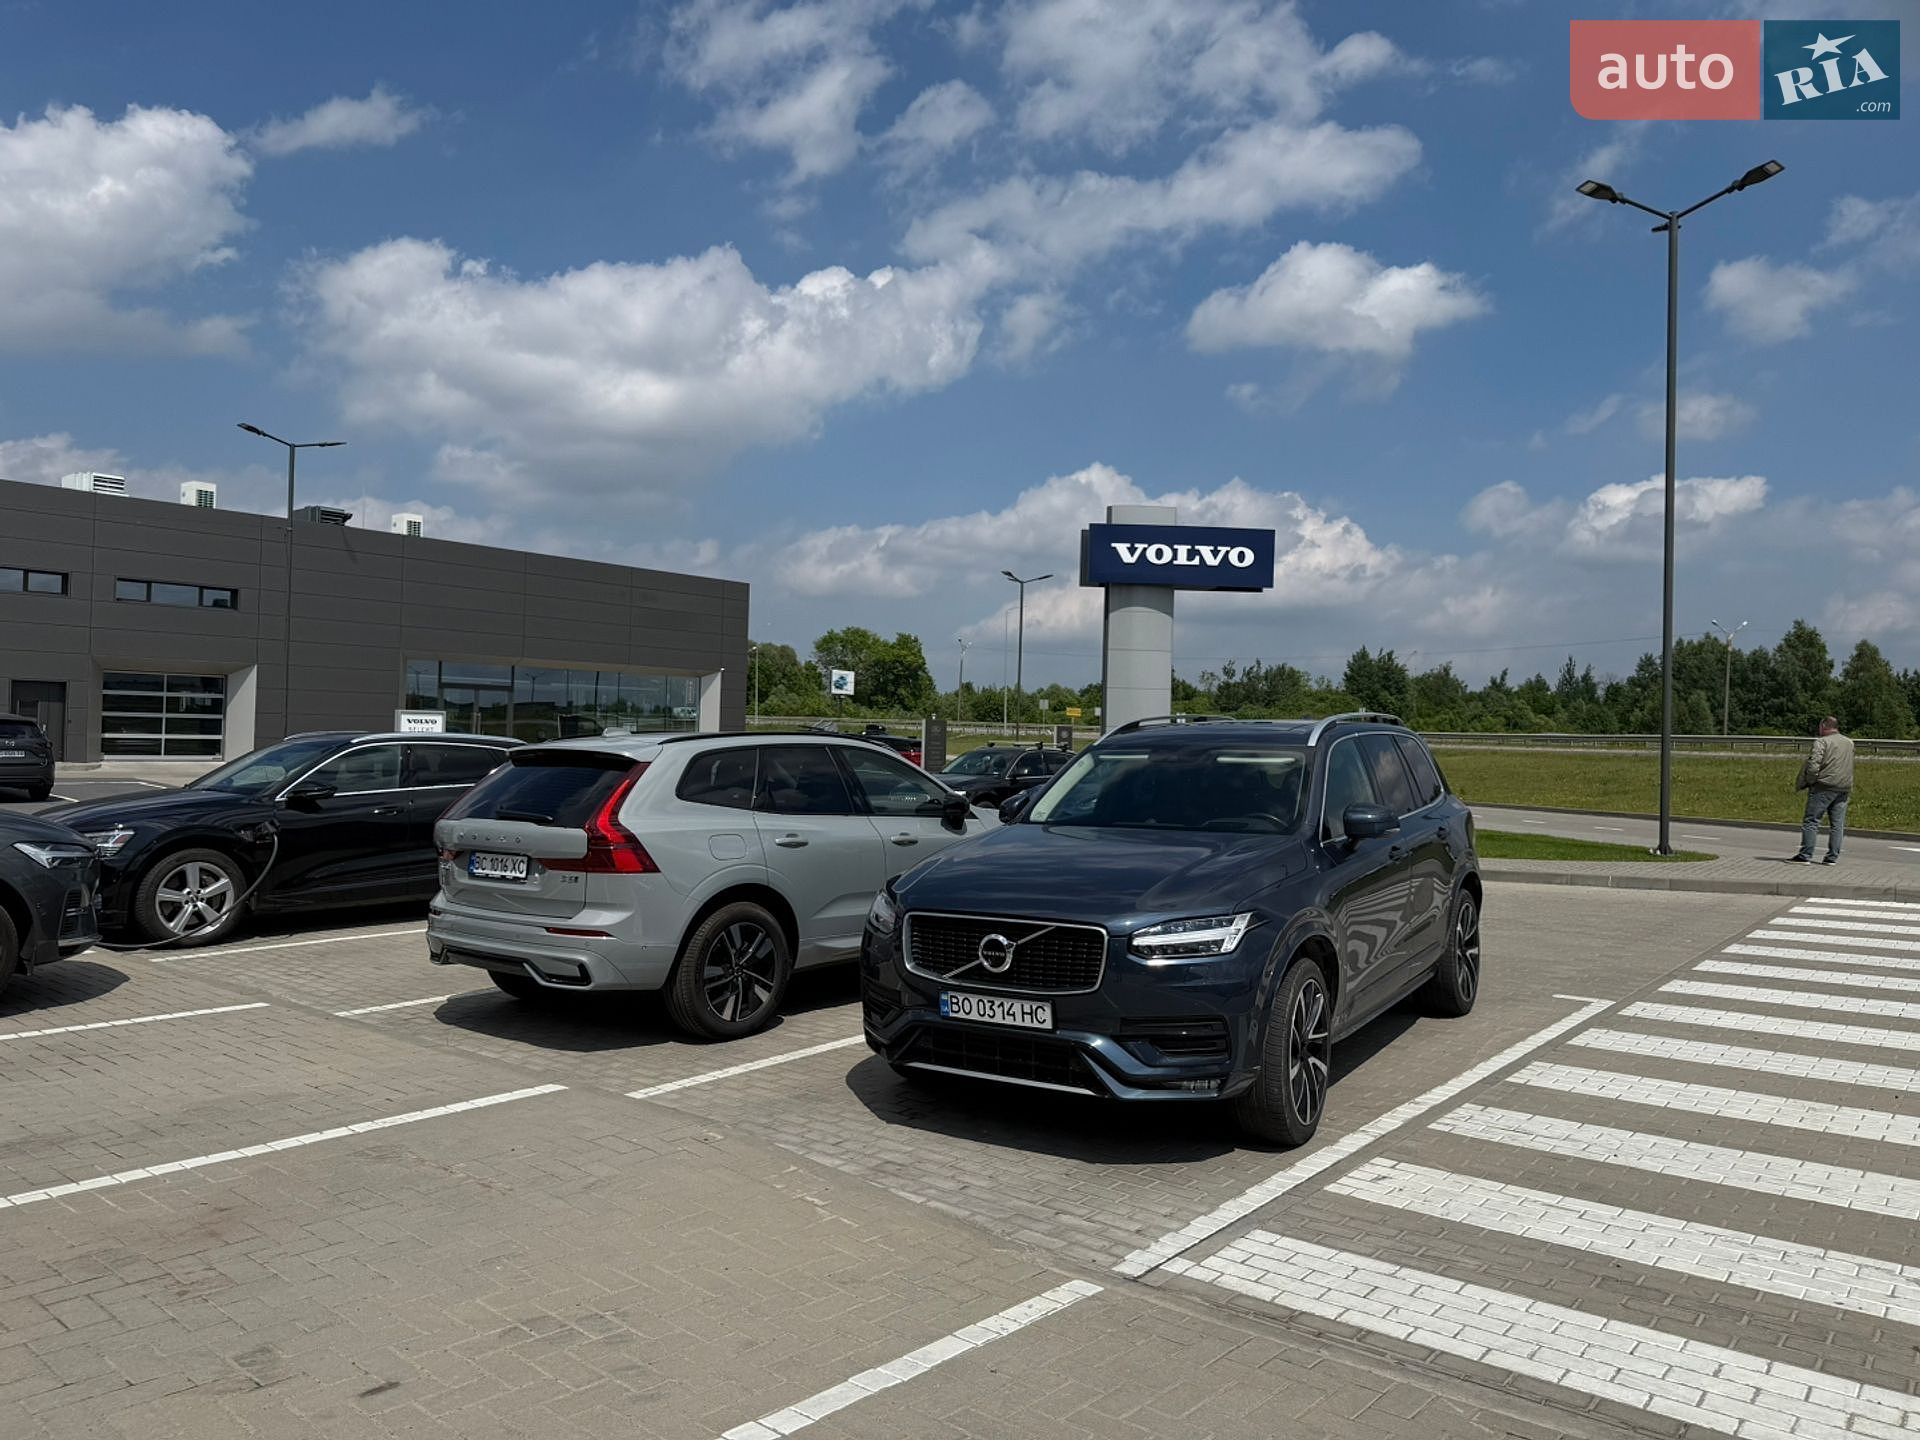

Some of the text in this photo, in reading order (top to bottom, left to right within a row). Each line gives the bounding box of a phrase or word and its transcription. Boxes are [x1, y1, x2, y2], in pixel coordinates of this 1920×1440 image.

[1111, 543, 1255, 568] VOLVO
[949, 995, 1047, 1024] BO 0314 HC
